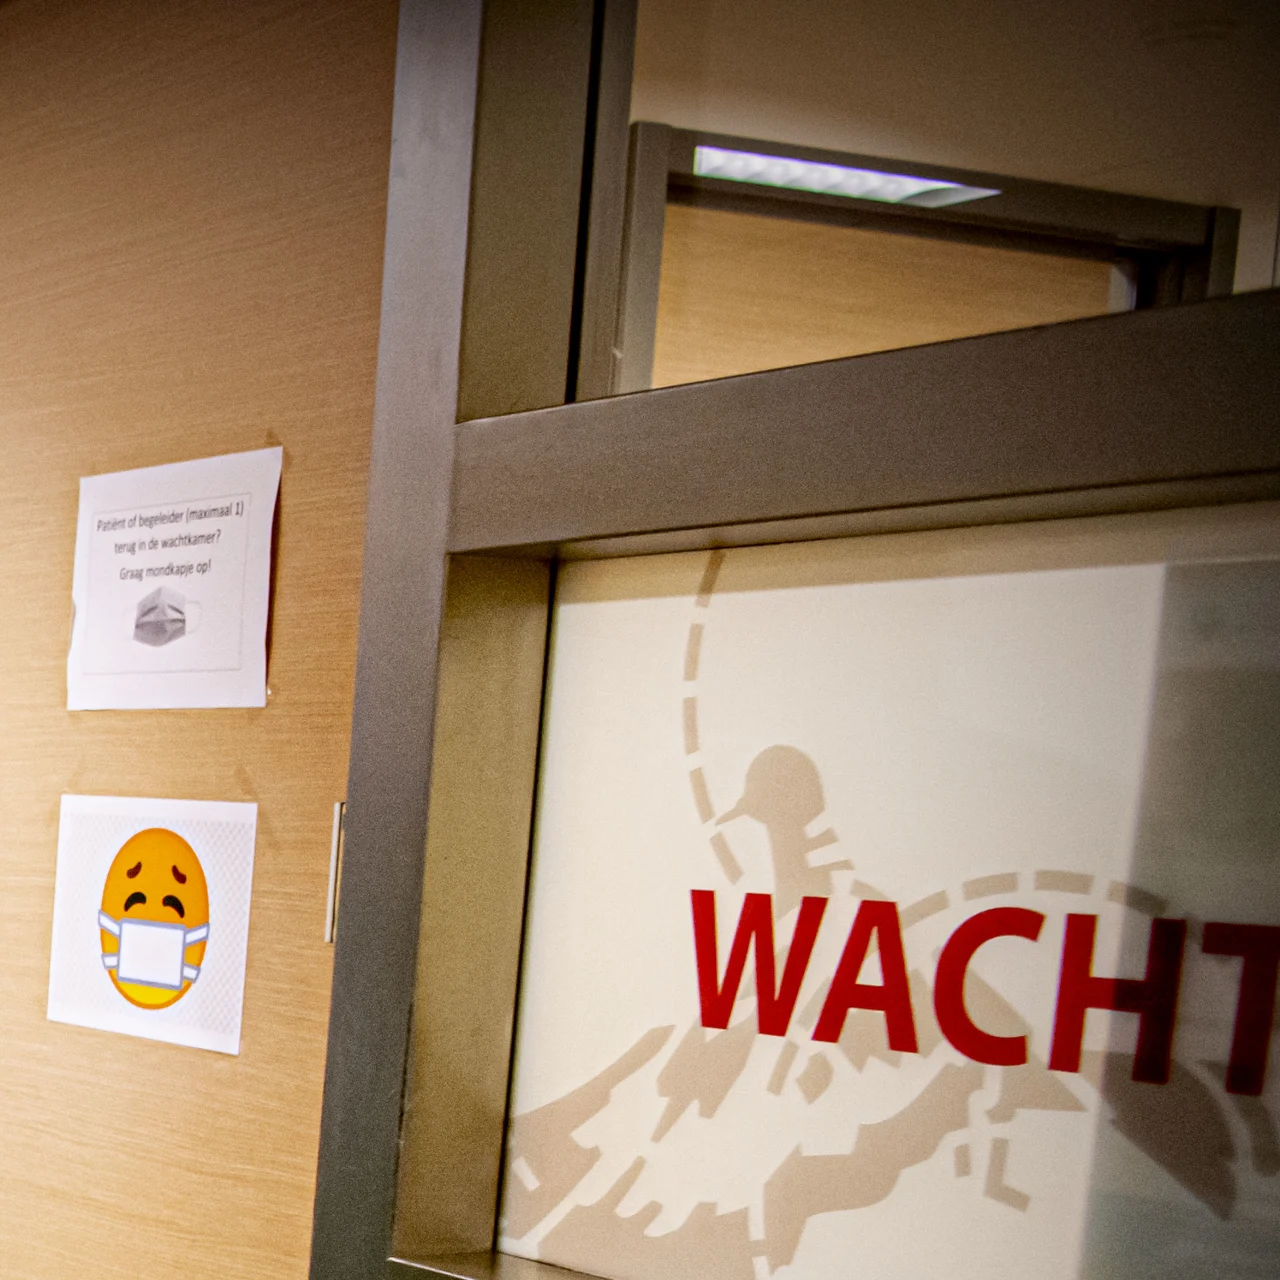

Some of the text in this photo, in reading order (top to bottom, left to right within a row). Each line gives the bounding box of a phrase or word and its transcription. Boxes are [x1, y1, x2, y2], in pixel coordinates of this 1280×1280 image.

[127, 514, 137, 529] of
[138, 510, 184, 529] begeleider
[185, 503, 233, 524] (maximaal
[235, 500, 245, 518] 1)
[114, 528, 222, 556] terug in de wachtkamer?
[119, 558, 212, 582] Graag mondkapje op!
[689, 888, 1280, 1097] WACHT
